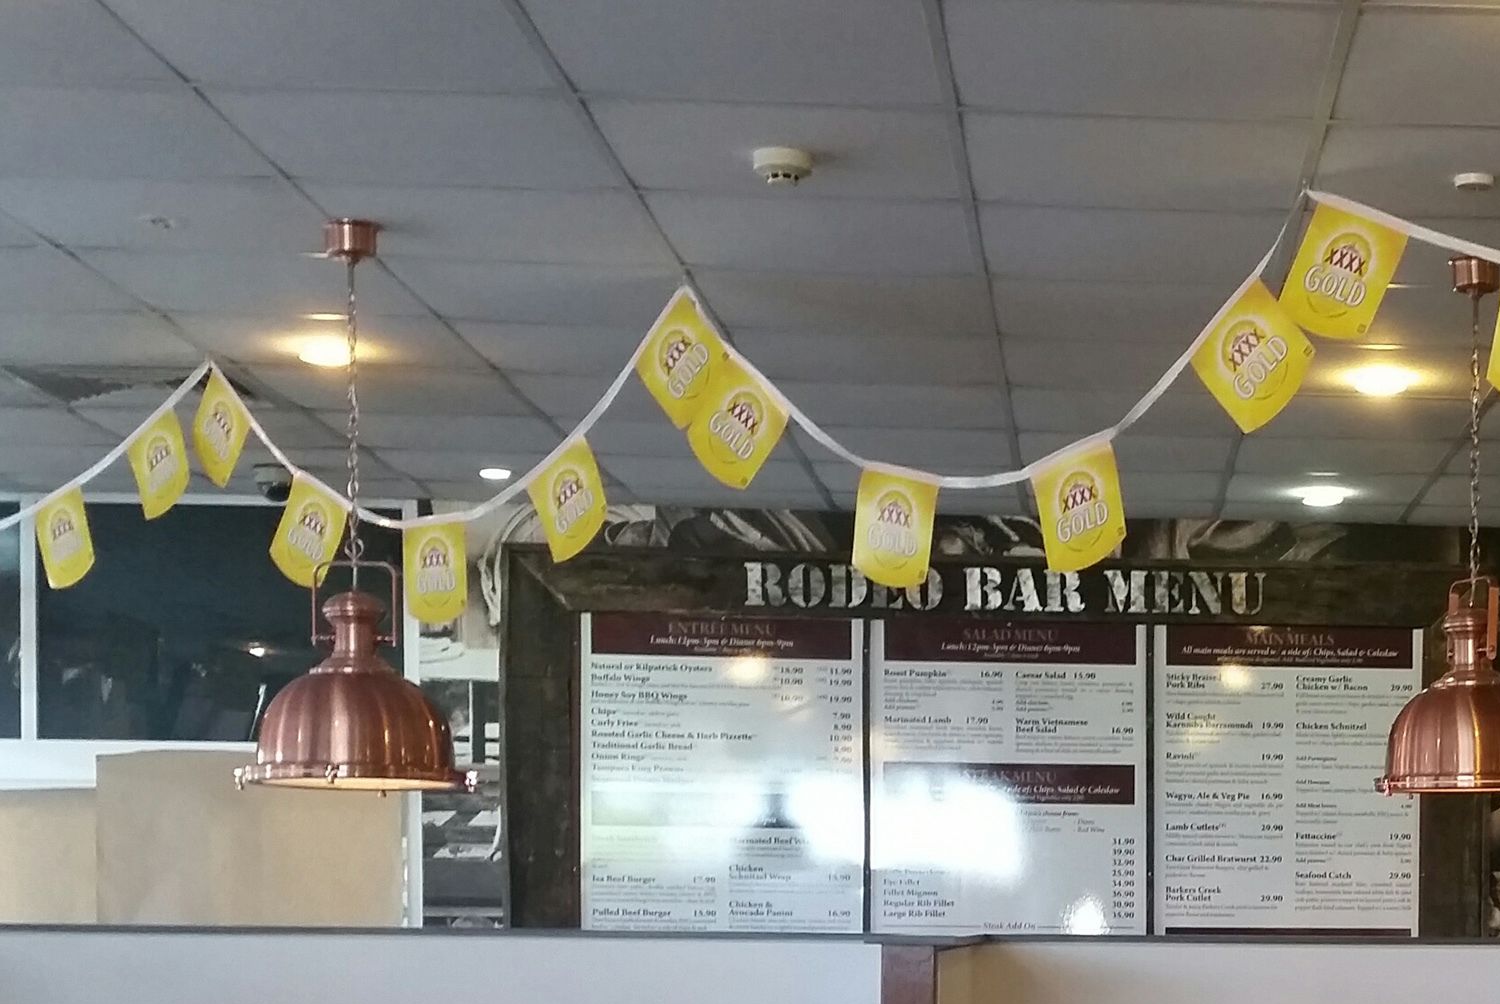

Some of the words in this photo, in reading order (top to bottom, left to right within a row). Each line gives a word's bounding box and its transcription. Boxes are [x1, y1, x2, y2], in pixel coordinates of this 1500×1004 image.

[1324, 247, 1366, 276] XXXX
[1303, 263, 1367, 307] GOLD
[1228, 328, 1266, 372] XXXX
[664, 335, 692, 377] XXXX
[667, 342, 709, 399] GOLD
[1232, 335, 1289, 400] GOLD
[728, 402, 759, 434] XXXX
[709, 411, 755, 460] GOLD
[556, 477, 583, 505] XXXX
[1061, 485, 1098, 515] XXXX
[554, 490, 594, 535] GOLD
[877, 507, 911, 529] XXXX
[1055, 500, 1109, 544] GOLD
[867, 523, 918, 556] GOLD
[416, 569, 455, 595] GOLD
[743, 563, 944, 611] RODEO
[963, 566, 1085, 613] BAR
[1103, 569, 1265, 617] MENU
[731, 622, 776, 637] MENU
[1014, 628, 1059, 642] MENU
[1246, 631, 1283, 645] MAIN
[1286, 633, 1335, 646] MEALS
[1193, 646, 1212, 655] main
[1212, 646, 1233, 655] meals
[1247, 647, 1270, 655] served
[1287, 647, 1302, 656] side
[1337, 648, 1358, 657] Salad
[1366, 648, 1399, 657] Coleslaw
[591, 662, 622, 671] Natural
[635, 663, 678, 673] Kilpatrick
[680, 664, 712, 673] Oysters
[884, 668, 907, 677] Roast
[909, 669, 947, 679] Pumpkin
[1015, 671, 1042, 680] Caesar
[1044, 671, 1066, 680] Salad
[1166, 673, 1190, 682] Sticky
[591, 673, 621, 682] Buffalo
[623, 674, 650, 684] Wings
[1295, 675, 1326, 684] Creamy
[1328, 675, 1352, 683] Garlic
[1187, 681, 1205, 689] Ribs
[1295, 683, 1329, 691] Chicken
[591, 690, 619, 699] Honey
[621, 691, 636, 701] Soy
[638, 691, 659, 701] BBQ
[661, 692, 687, 702] Wings
[591, 708, 616, 717] Chips
[1166, 712, 1186, 720] Wild
[1187, 713, 1216, 721] Caught
[591, 719, 615, 728] Curly
[617, 719, 638, 728] Fries
[884, 715, 926, 724] Marinated
[928, 716, 951, 724] Lamb
[1015, 717, 1040, 726] Warm
[1041, 718, 1088, 726] Vietnamese
[1205, 721, 1253, 729] Barramundi
[1261, 722, 1284, 730] 19.90
[1295, 722, 1329, 730] Chicken
[1330, 722, 1367, 730] Schnitzel
[1035, 726, 1057, 734] Salad
[1111, 726, 1134, 735] 16.90
[591, 730, 625, 738] Roasted
[627, 731, 651, 739] Garlic
[654, 731, 685, 739] Cheese
[697, 732, 718, 740] Herb
[592, 741, 638, 749] Traditional
[640, 742, 664, 750] Garlic
[668, 743, 692, 751] Bread
[621, 753, 645, 762] Rings
[1166, 752, 1195, 760] Ravioli
[1261, 753, 1284, 761] 19.90
[1012, 770, 1058, 784] MENU
[1166, 792, 1195, 801] Wagyu,
[1196, 792, 1210, 800] Ale
[1220, 792, 1236, 801] Veg
[1237, 792, 1250, 800] Pie
[1260, 792, 1283, 800] 16.90
[1166, 823, 1189, 831] Lamb
[1112, 837, 1135, 846] 31.90
[1389, 833, 1412, 841] 19.90
[1165, 854, 1185, 862] Char
[1187, 854, 1216, 862] Grilled
[1259, 855, 1283, 863] 22.90
[728, 864, 763, 872] Chicken
[768, 873, 791, 882] Wrap
[1295, 871, 1327, 879] Seafood
[1388, 872, 1412, 880] 29.90
[628, 876, 655, 885] Burger
[906, 889, 938, 898] Mignon
[1166, 886, 1196, 894] Barkers
[1198, 886, 1222, 894] Creek
[1166, 894, 1185, 902] Pork
[1186, 894, 1212, 902] Cutlet
[728, 900, 763, 909] Chicken
[883, 900, 915, 908] Regular
[933, 900, 955, 908] Fillet
[592, 908, 619, 916] Pulled
[621, 909, 641, 917] Beef
[642, 909, 671, 918] Burger
[728, 909, 764, 917] Avocado
[766, 909, 793, 917] Panini
[883, 910, 907, 919] Large
[908, 910, 923, 918] Rib
[924, 910, 945, 918] Fillet
[1005, 922, 1022, 930] Add
[1023, 922, 1036, 930] On
